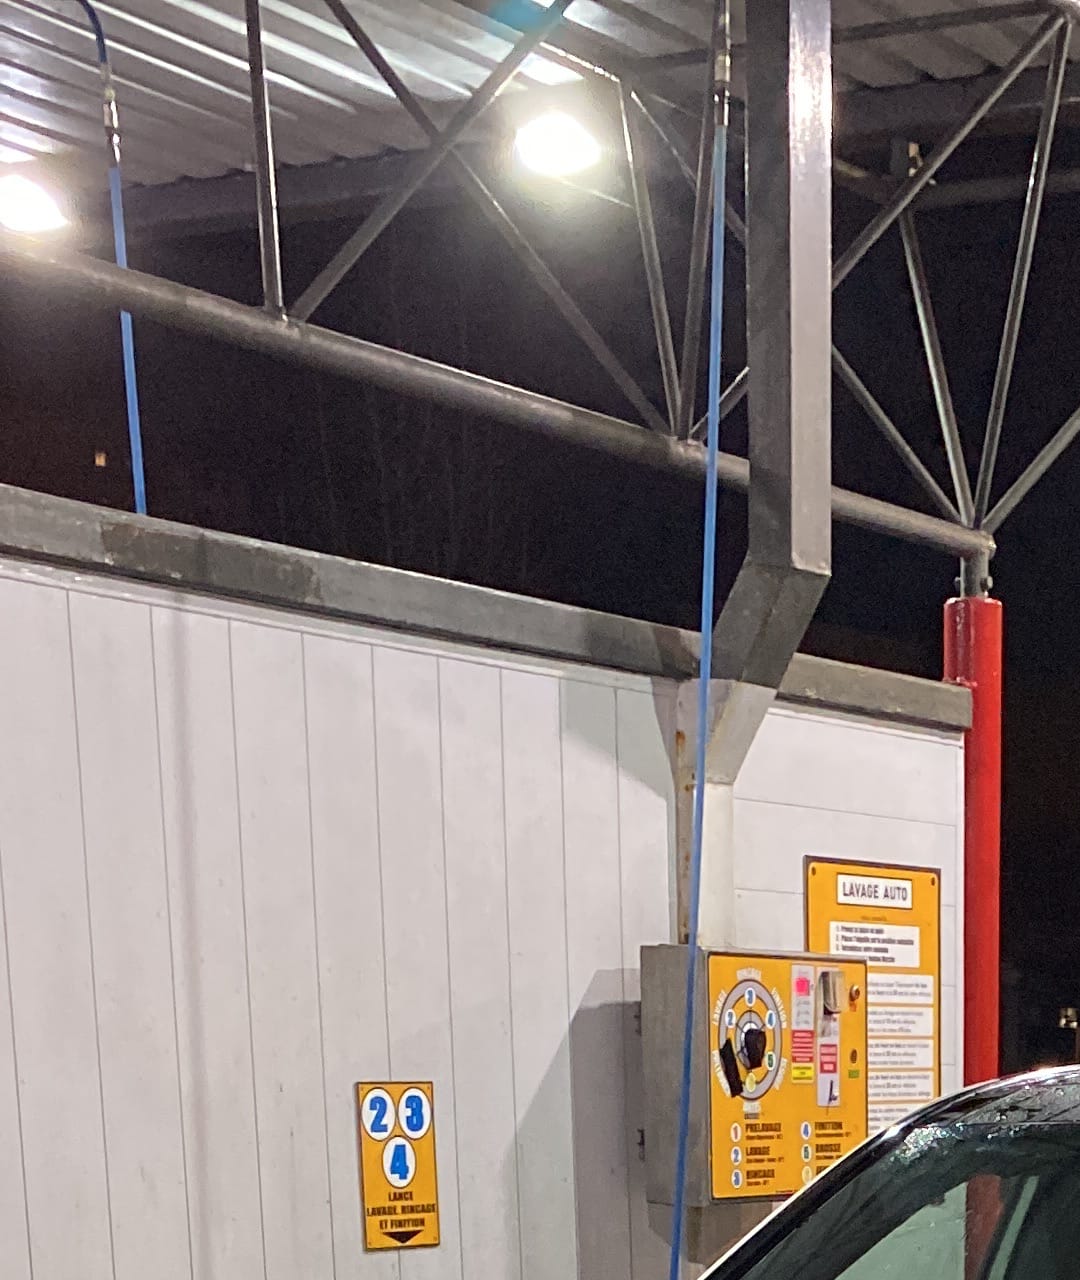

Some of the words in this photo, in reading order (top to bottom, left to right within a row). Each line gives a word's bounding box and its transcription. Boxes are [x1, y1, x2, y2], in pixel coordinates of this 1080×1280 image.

[842, 881, 879, 899] LAVAGE
[883, 885, 908, 901] AUTO
[369, 1096, 388, 1133] 2
[405, 1095, 424, 1132] 3
[389, 1144, 410, 1180] 4
[388, 1191, 414, 1202] LANCE
[379, 1219, 389, 1230] ET
